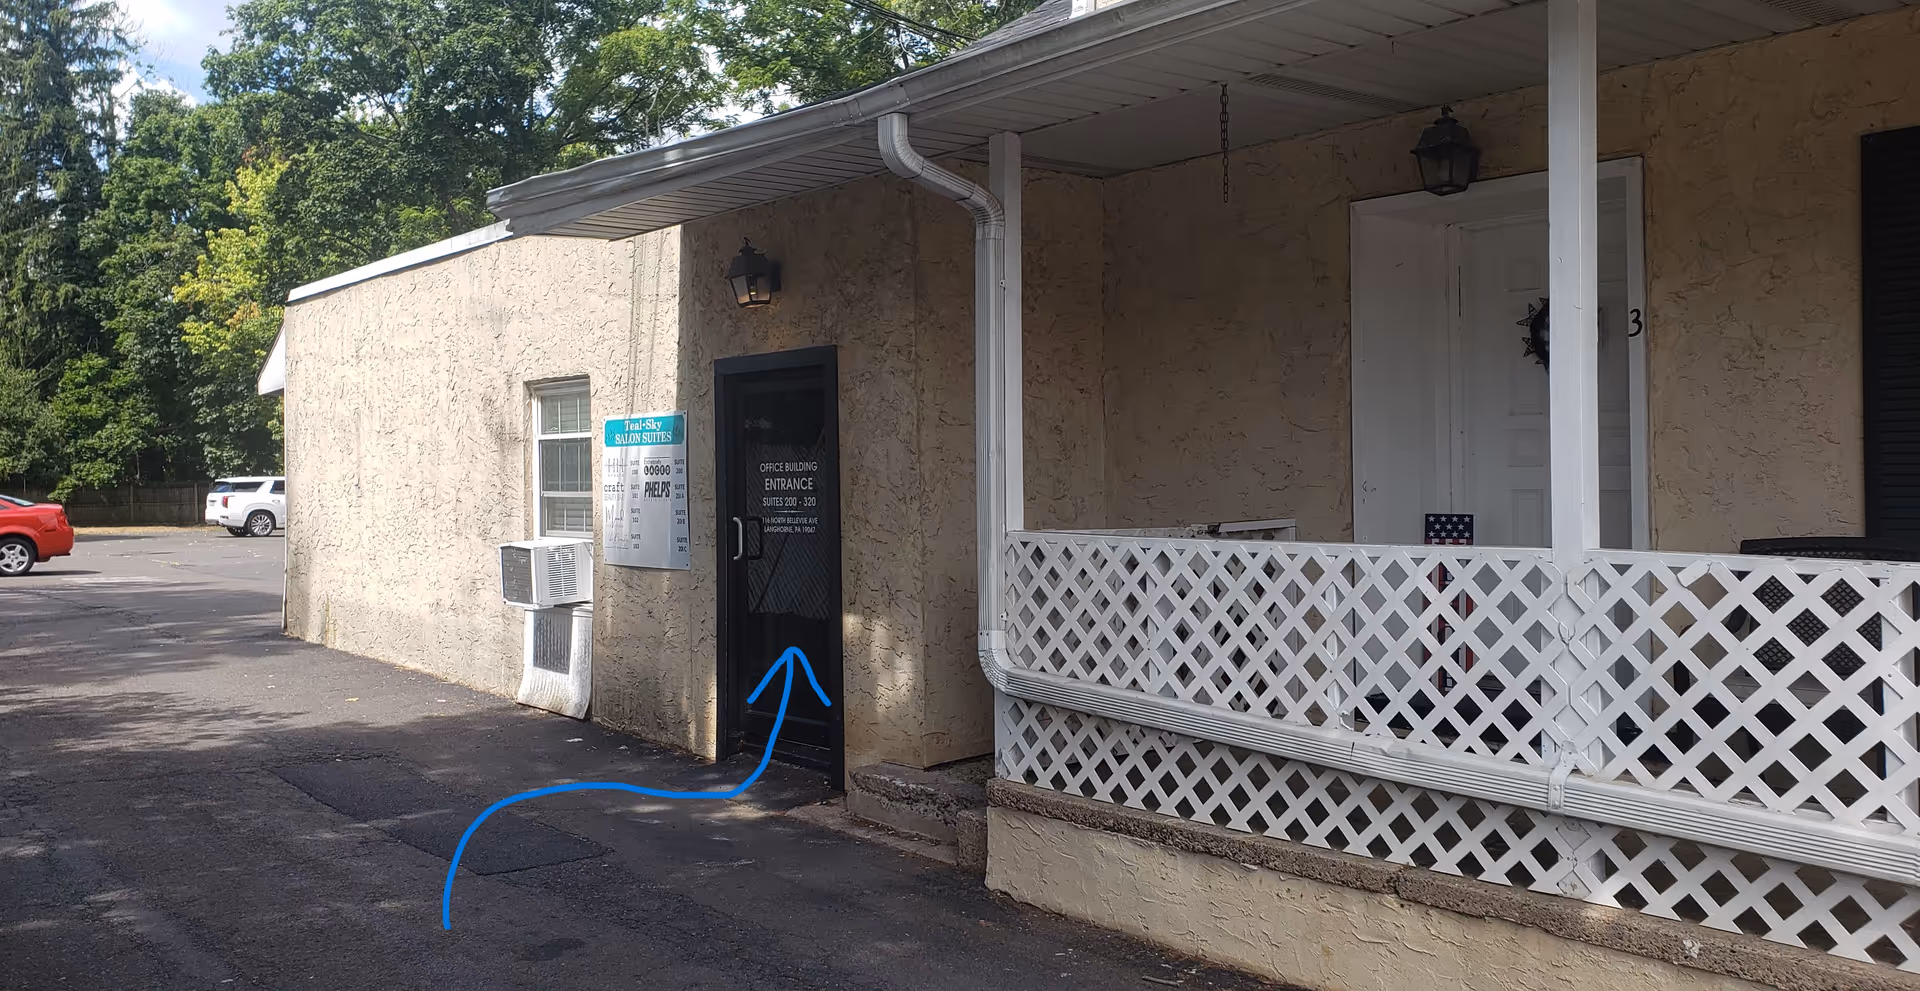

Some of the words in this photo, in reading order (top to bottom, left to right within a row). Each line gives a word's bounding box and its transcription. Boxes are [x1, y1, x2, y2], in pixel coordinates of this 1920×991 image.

[1628, 308, 1643, 337] 3
[615, 432, 641, 444] SALON
[642, 431, 672, 443] SUITES
[760, 462, 784, 472] OFFICE
[785, 461, 818, 471] BUILDING
[604, 482, 624, 492] craft
[644, 481, 671, 498] PHELPS
[765, 477, 813, 490] ENTRANCE
[763, 497, 783, 506] SUITES
[784, 496, 797, 506] 200
[803, 496, 816, 506] 320
